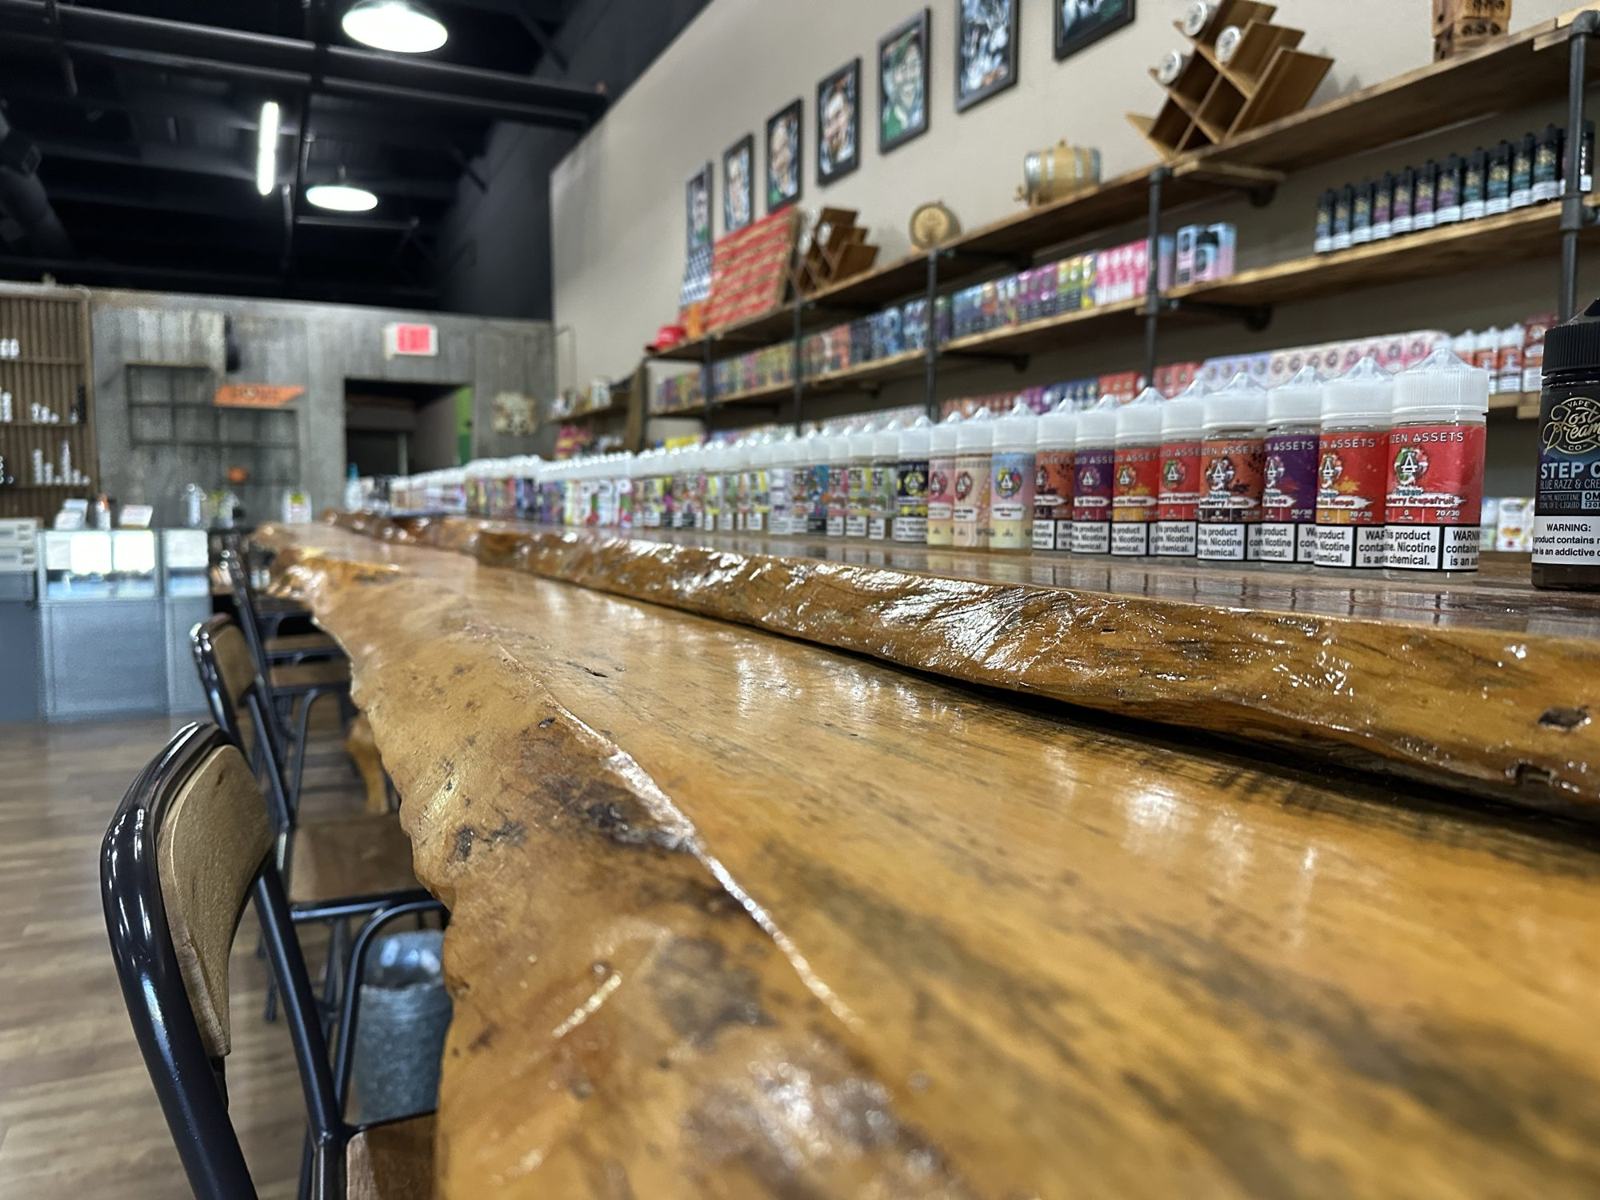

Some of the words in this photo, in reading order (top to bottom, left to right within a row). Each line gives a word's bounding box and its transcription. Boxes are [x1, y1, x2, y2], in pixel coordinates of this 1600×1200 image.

[1567, 400, 1591, 408] VAPE
[1412, 432, 1464, 442] ASSETS
[1272, 440, 1314, 450] ASSETS
[1330, 439, 1375, 449] ASSETS
[1540, 461, 1585, 479] STEP
[1554, 480, 1573, 490] RAZZ
[1575, 480, 1582, 489] &
[1207, 526, 1237, 537] product
[1546, 523, 1591, 532] WARNING:
[1395, 530, 1431, 541] product
[1556, 536, 1595, 545] contains
[1210, 536, 1242, 546] Nicotine
[1397, 541, 1436, 553] Nicotine
[1554, 548, 1595, 557] addictive
[1450, 555, 1458, 566] is
